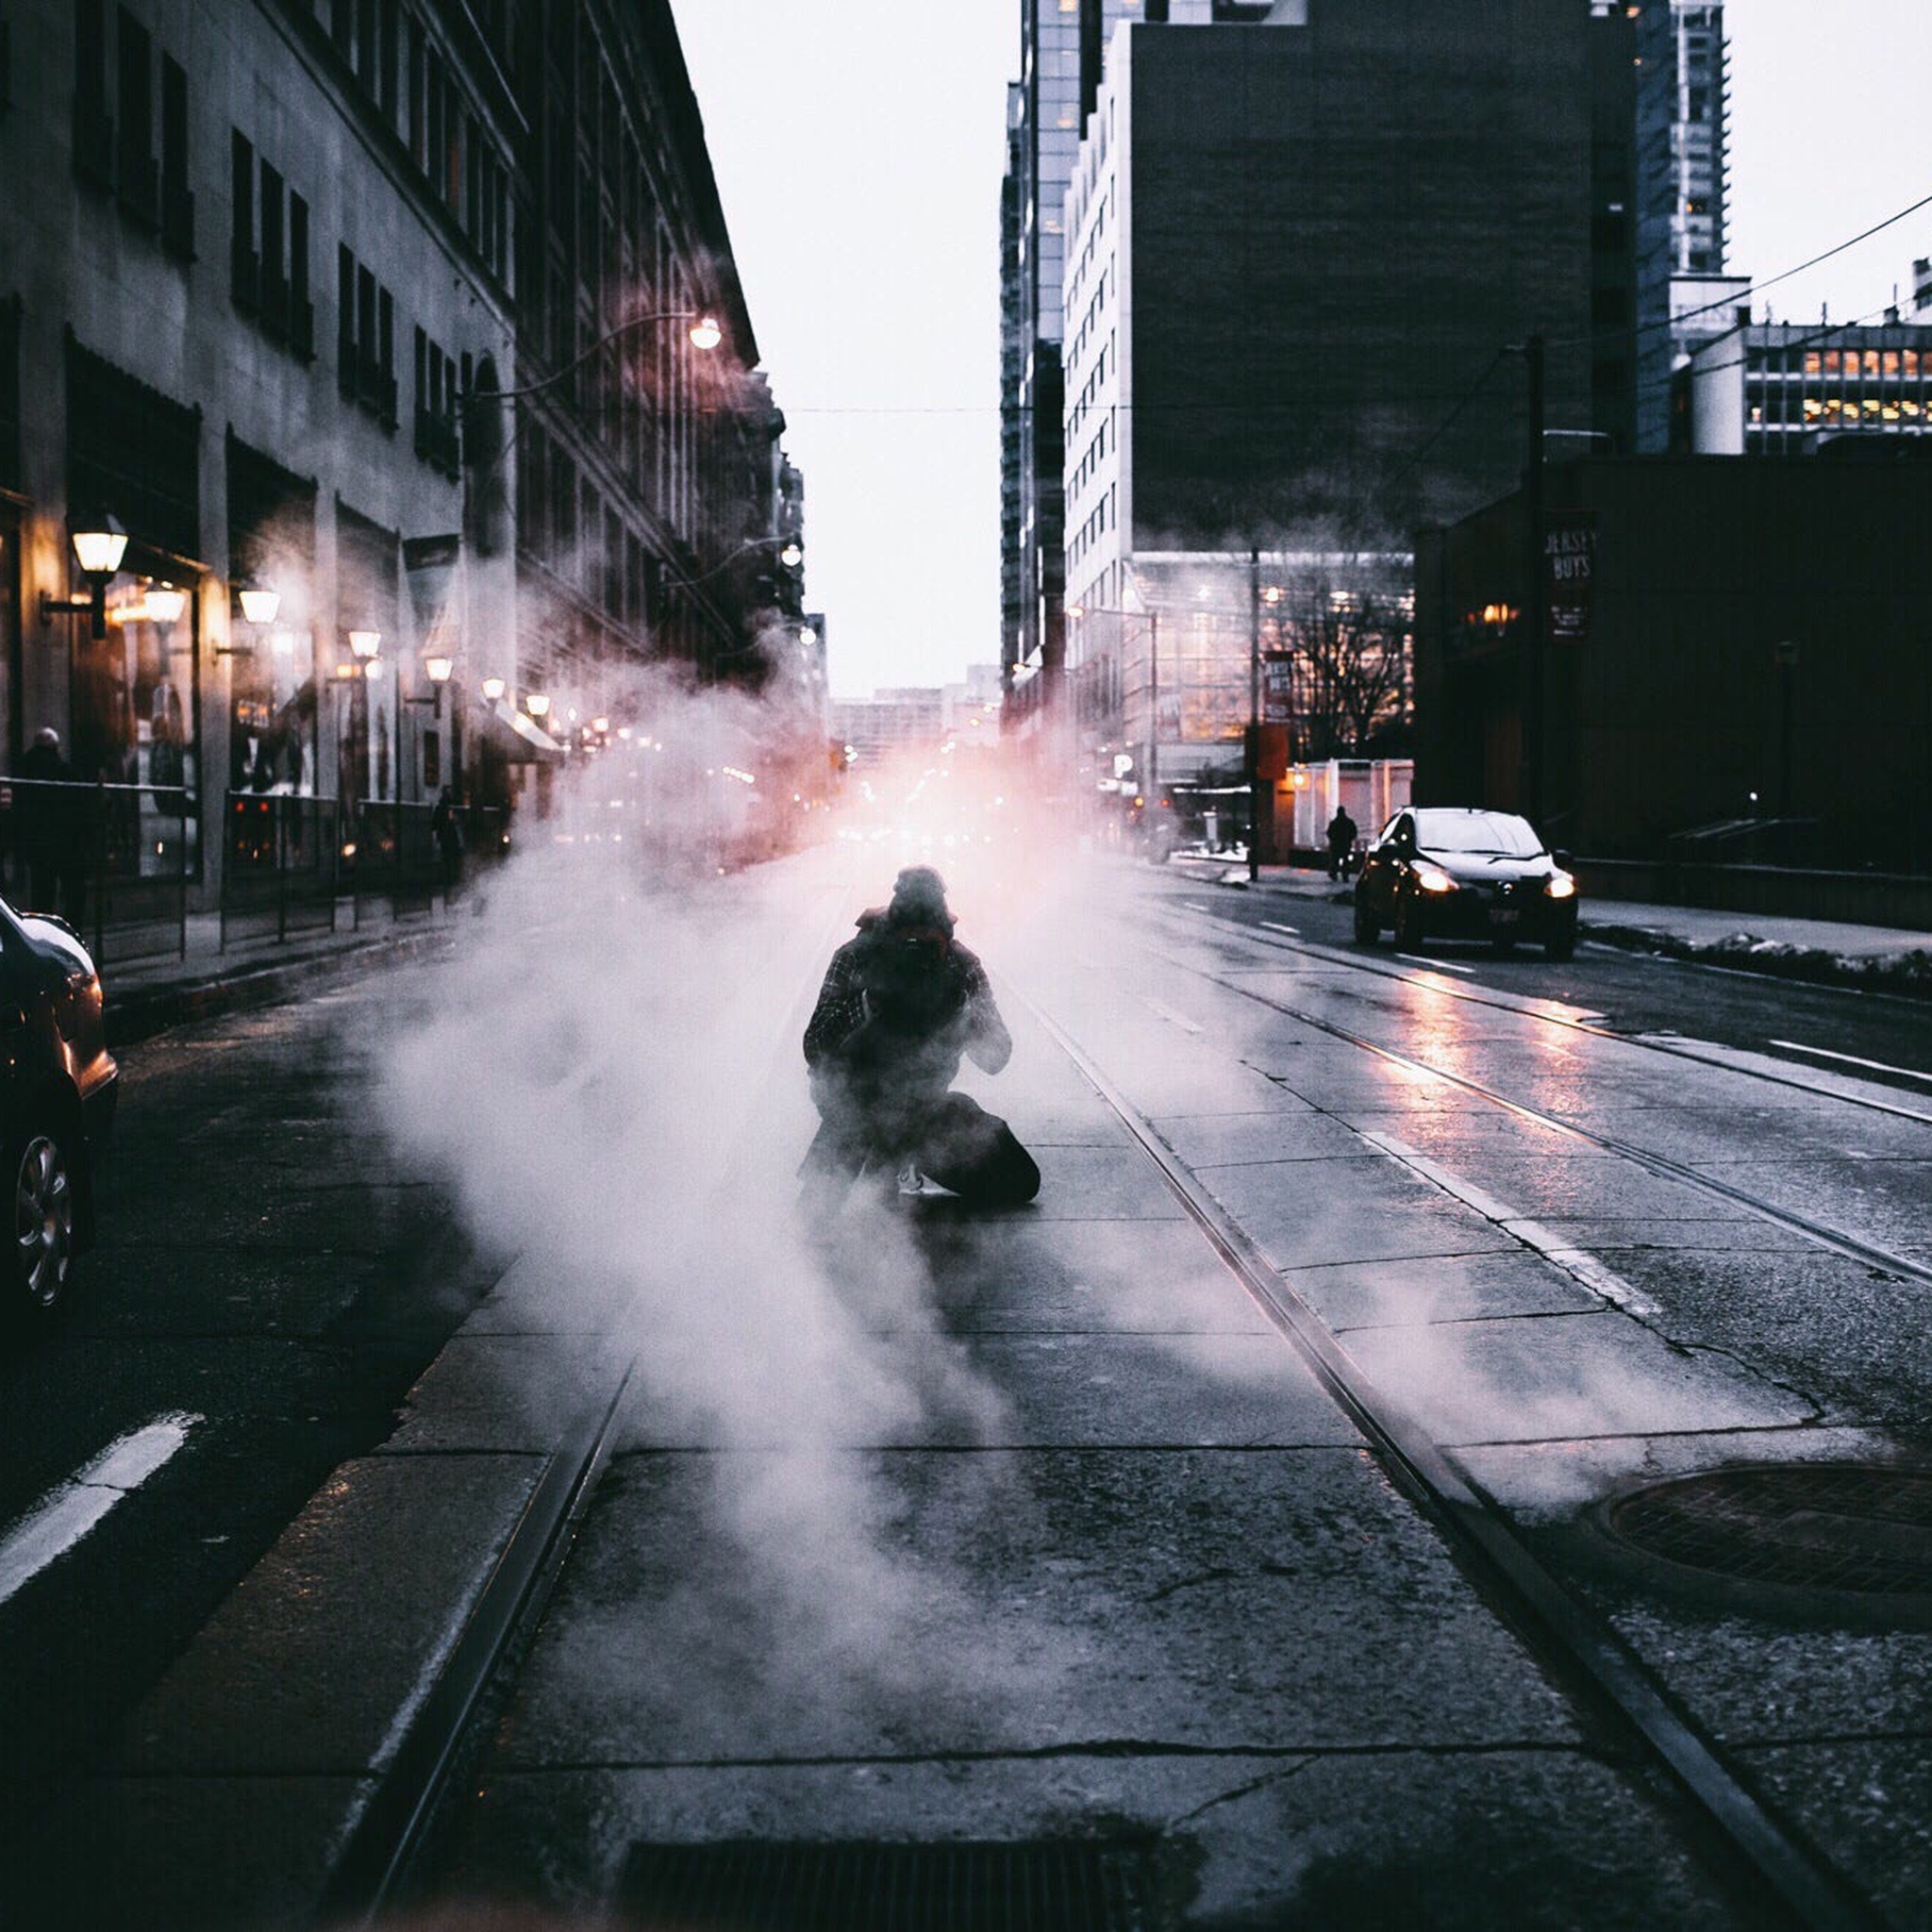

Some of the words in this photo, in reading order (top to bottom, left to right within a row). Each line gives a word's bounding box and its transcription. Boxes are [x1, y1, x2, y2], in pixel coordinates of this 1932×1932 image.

[1544, 530, 1598, 554] JERSEY
[1553, 556, 1591, 580] BOYS
[1114, 755, 1133, 778] P
